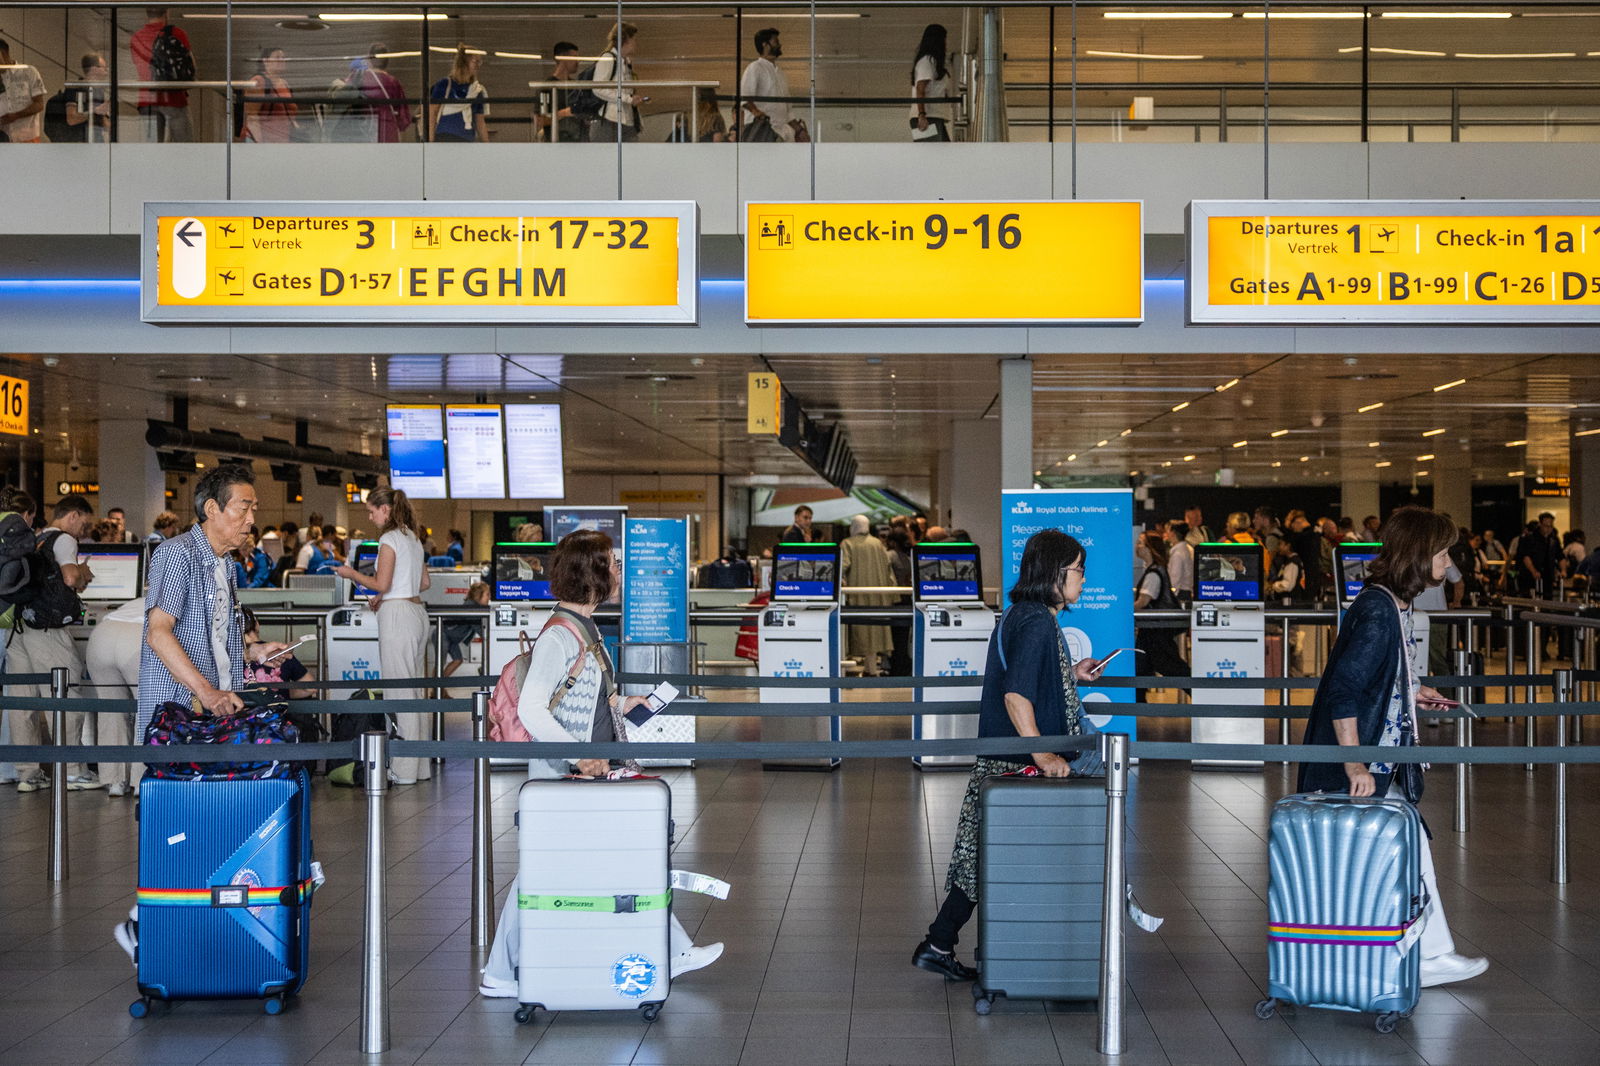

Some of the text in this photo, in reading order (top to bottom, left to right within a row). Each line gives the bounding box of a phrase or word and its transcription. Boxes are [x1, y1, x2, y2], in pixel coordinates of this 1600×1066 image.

[253, 216, 348, 233] Departures
[804, 214, 1022, 250] Check-in 9-16
[1242, 221, 1338, 238] Departures
[356, 220, 374, 250] 3
[450, 220, 648, 250] Check-in 17-32
[1346, 224, 1361, 254] 1
[1436, 229, 1525, 247] Check-in
[1534, 224, 1574, 254] 1a
[252, 238, 302, 250] Vertrek
[1288, 242, 1338, 254] Vertrek
[252, 272, 312, 290] Gates
[1230, 277, 1290, 294] Gates
[755, 378, 770, 388] 15
[1, 381, 22, 418] 16
[1036, 506, 1056, 514] Royal
[1012, 524, 1043, 534] Please
[1068, 524, 1084, 534] the
[342, 671, 380, 680] KLM
